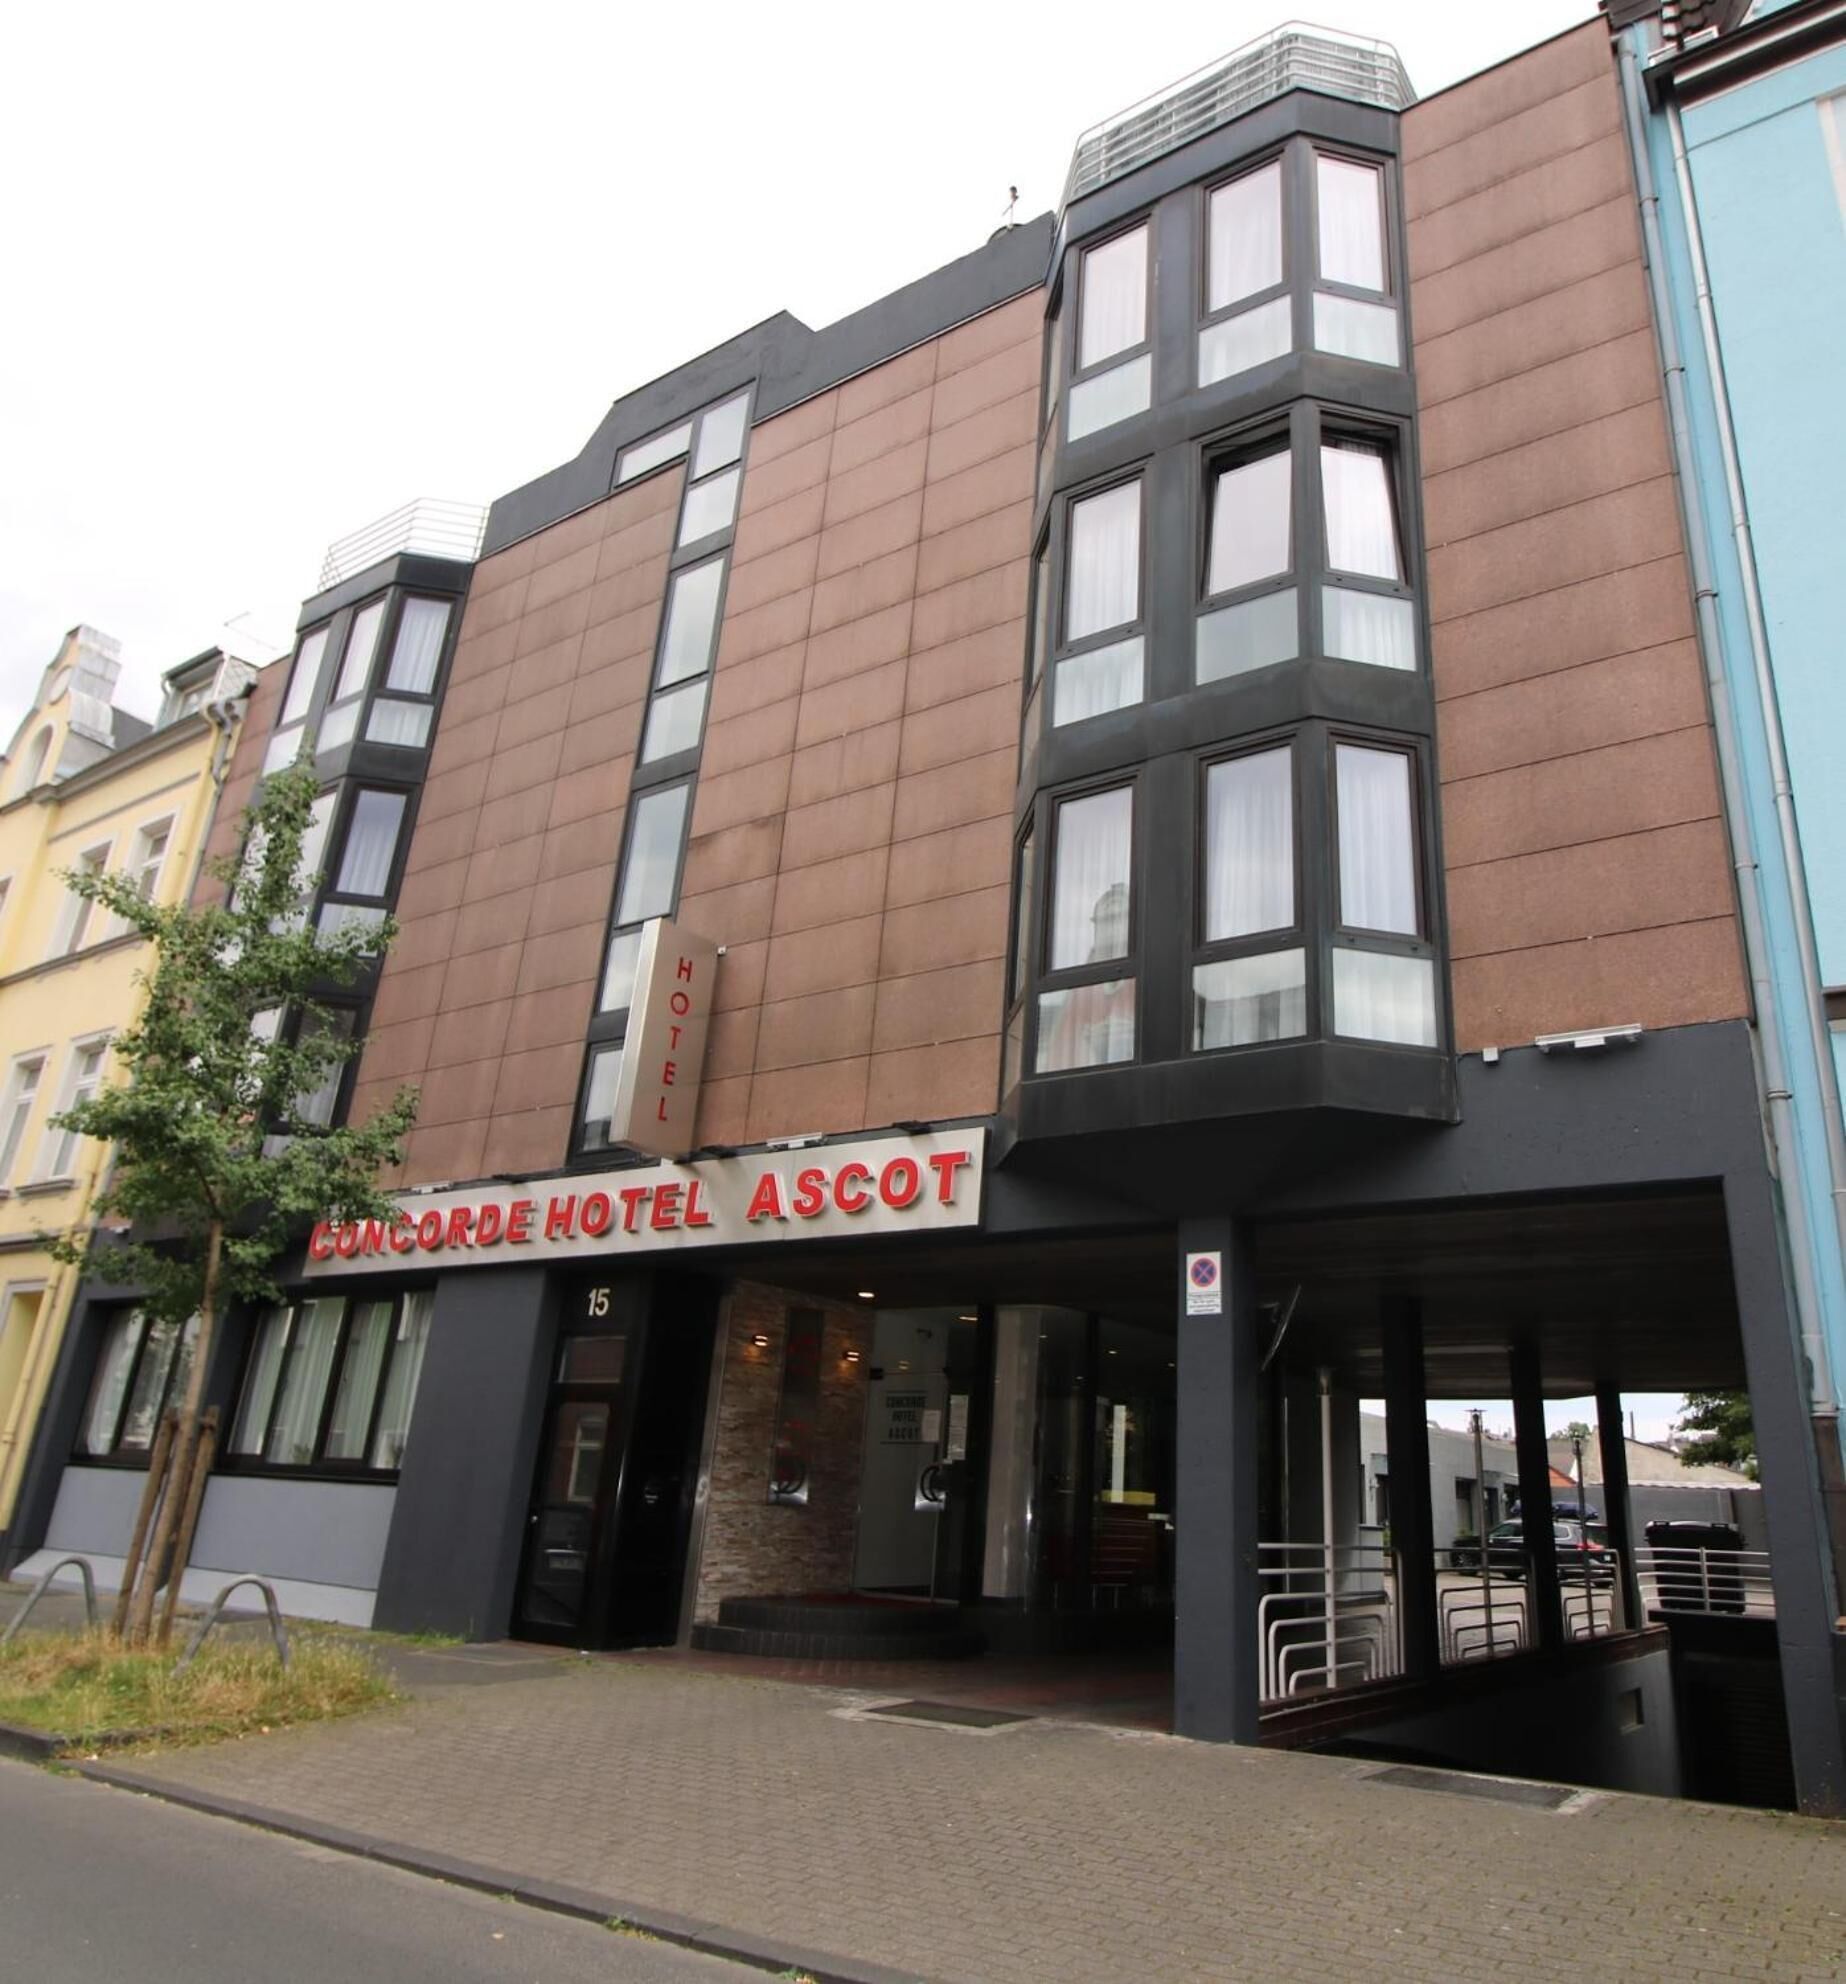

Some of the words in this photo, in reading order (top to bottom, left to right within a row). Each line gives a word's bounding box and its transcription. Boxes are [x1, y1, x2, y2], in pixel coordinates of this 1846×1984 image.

[658, 957, 693, 1121] HOTEL
[308, 1199, 533, 1260] CONCORDE
[544, 1180, 710, 1239] HOTEL
[747, 1151, 968, 1218] ASCOT
[588, 1287, 611, 1317] 15
